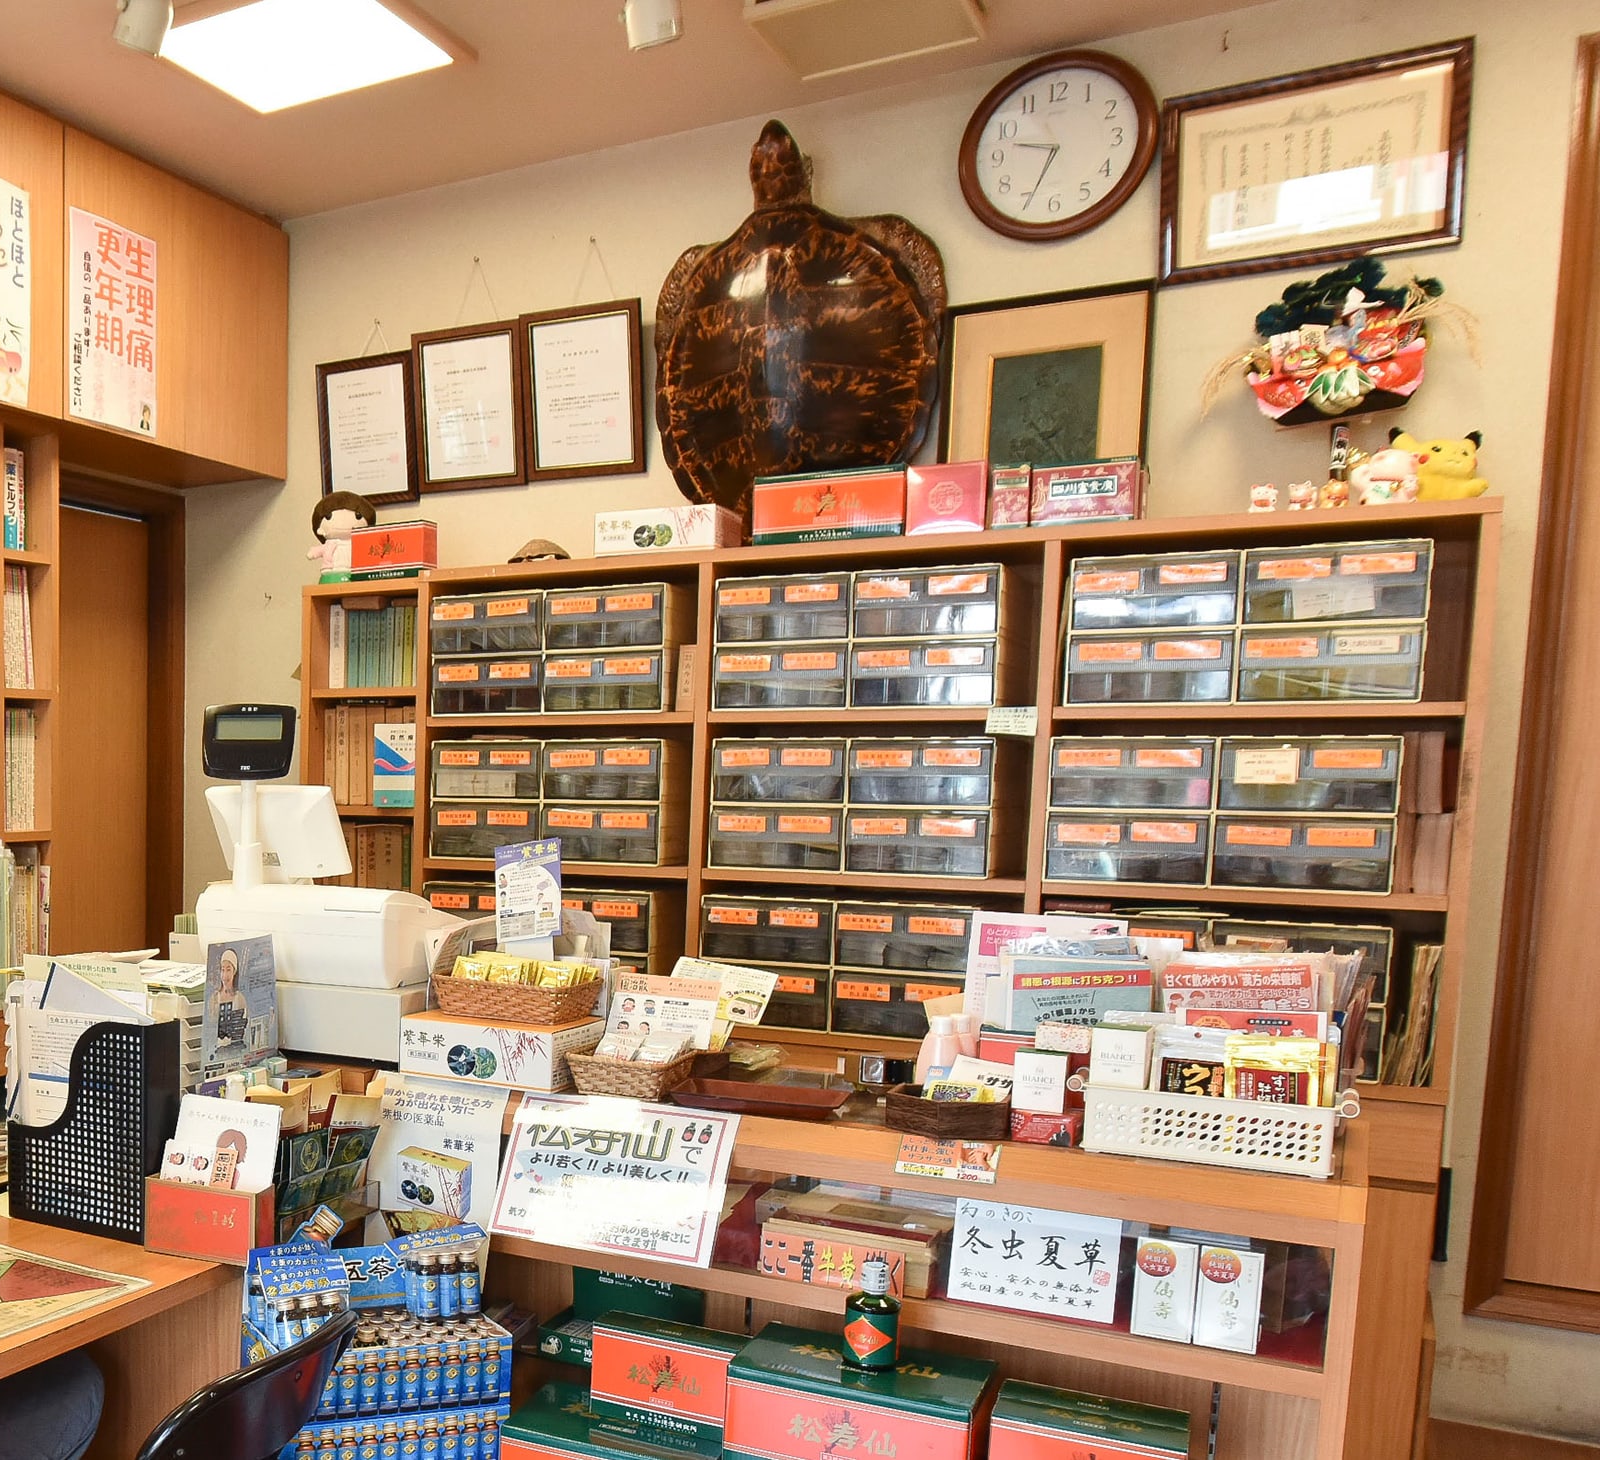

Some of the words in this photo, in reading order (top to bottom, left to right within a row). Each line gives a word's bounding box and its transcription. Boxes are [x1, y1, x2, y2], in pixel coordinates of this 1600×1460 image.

[1049, 82, 1068, 102] 12
[1084, 82, 1092, 102] 1
[1022, 94, 1036, 114] 11
[1104, 100, 1117, 120] 2
[998, 120, 1018, 140] 10
[1111, 127, 1123, 146] 3
[992, 149, 1004, 169] 9
[1098, 158, 1112, 177] 4
[999, 175, 1011, 194] 8
[1079, 182, 1091, 201] 5
[1021, 191, 1033, 211] 7
[1048, 193, 1060, 213] 6
[10, 196, 25, 289] ほとほと
[94, 221, 124, 358] 更年期
[125, 236, 155, 373] 生理痛
[403, 1030, 446, 1048] 紫華栄
[382, 1108, 444, 1127] 紫根の医薬品
[443, 1138, 475, 1153] 紫華栄
[961, 1203, 1032, 1224] 幻のきのこ
[959, 1225, 1106, 1275] 冬虫夏草
[1144, 1254, 1169, 1265] 純国産
[1142, 1262, 1172, 1274] 冬虫夏草
[1206, 1270, 1238, 1282] 冬虫夏草
[1208, 1261, 1234, 1272] 純国産
[961, 1281, 1095, 1309] 純国産の冬虫夏草
[627, 1364, 700, 1397] 松寿仙
[787, 1414, 897, 1459] 松寿仙
